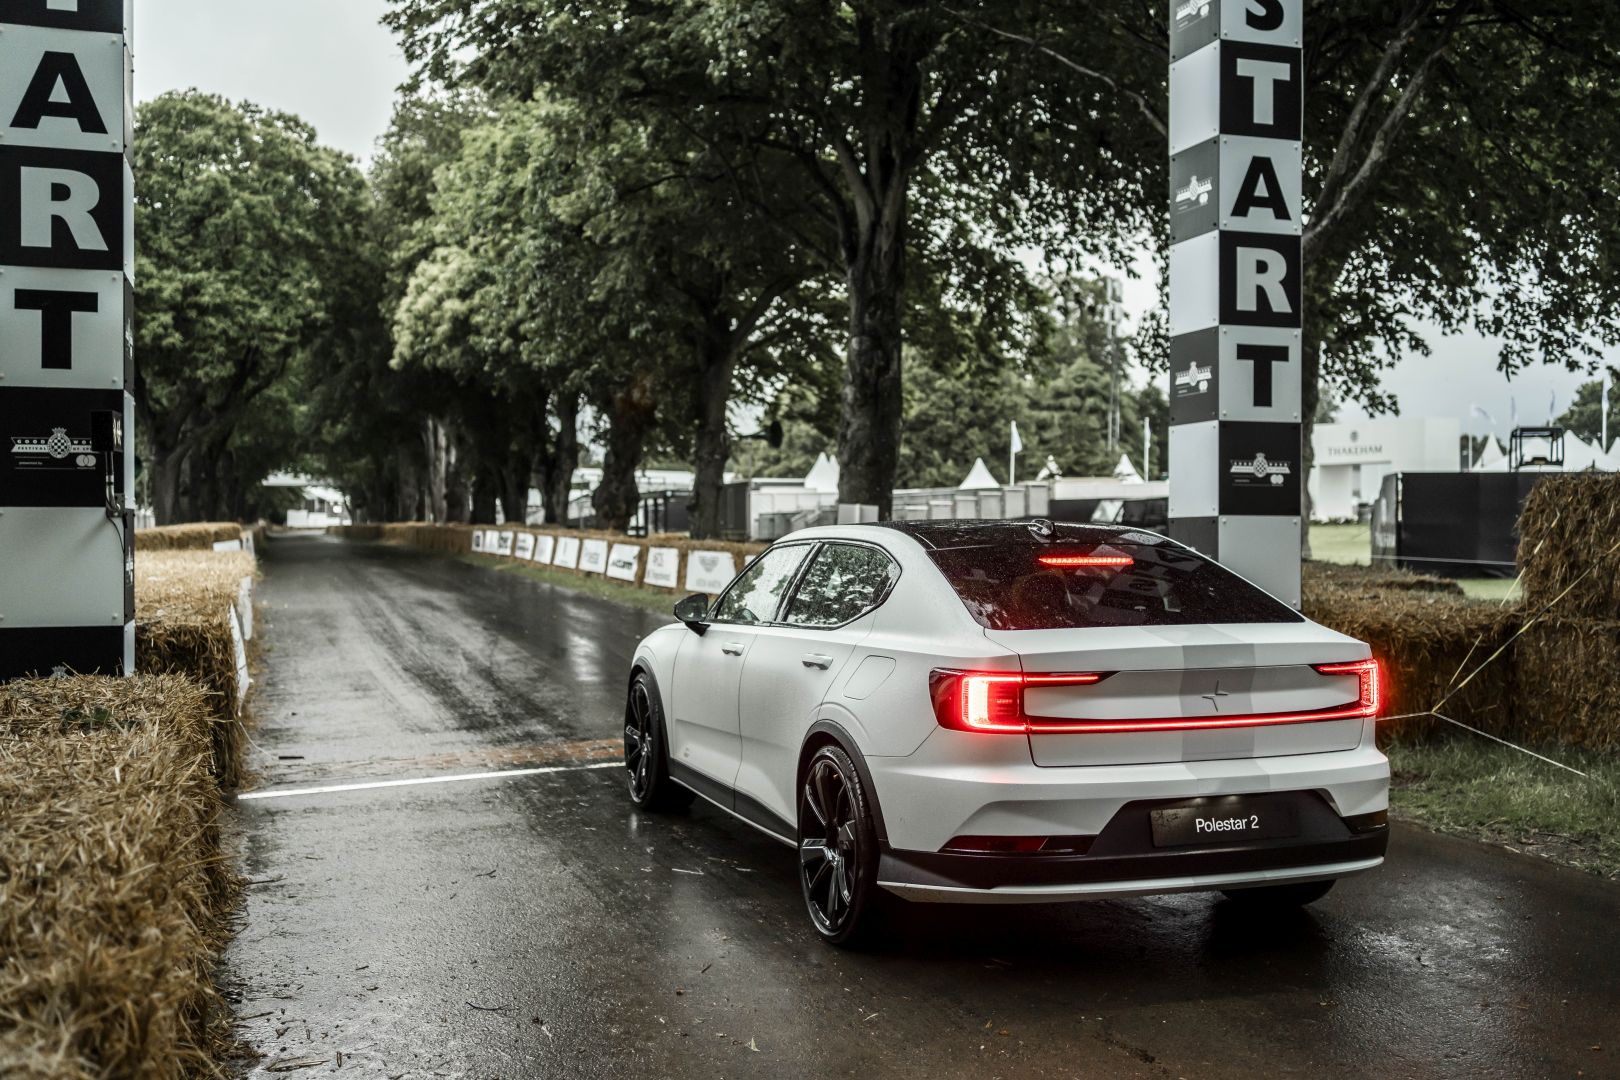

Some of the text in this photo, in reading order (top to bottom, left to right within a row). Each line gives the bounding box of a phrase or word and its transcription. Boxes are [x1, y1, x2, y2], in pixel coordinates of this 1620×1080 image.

[10, 0, 108, 369] ART
[1328, 445, 1383, 456] THAKEHAM
[1195, 815, 1259, 833] Polestar 2
